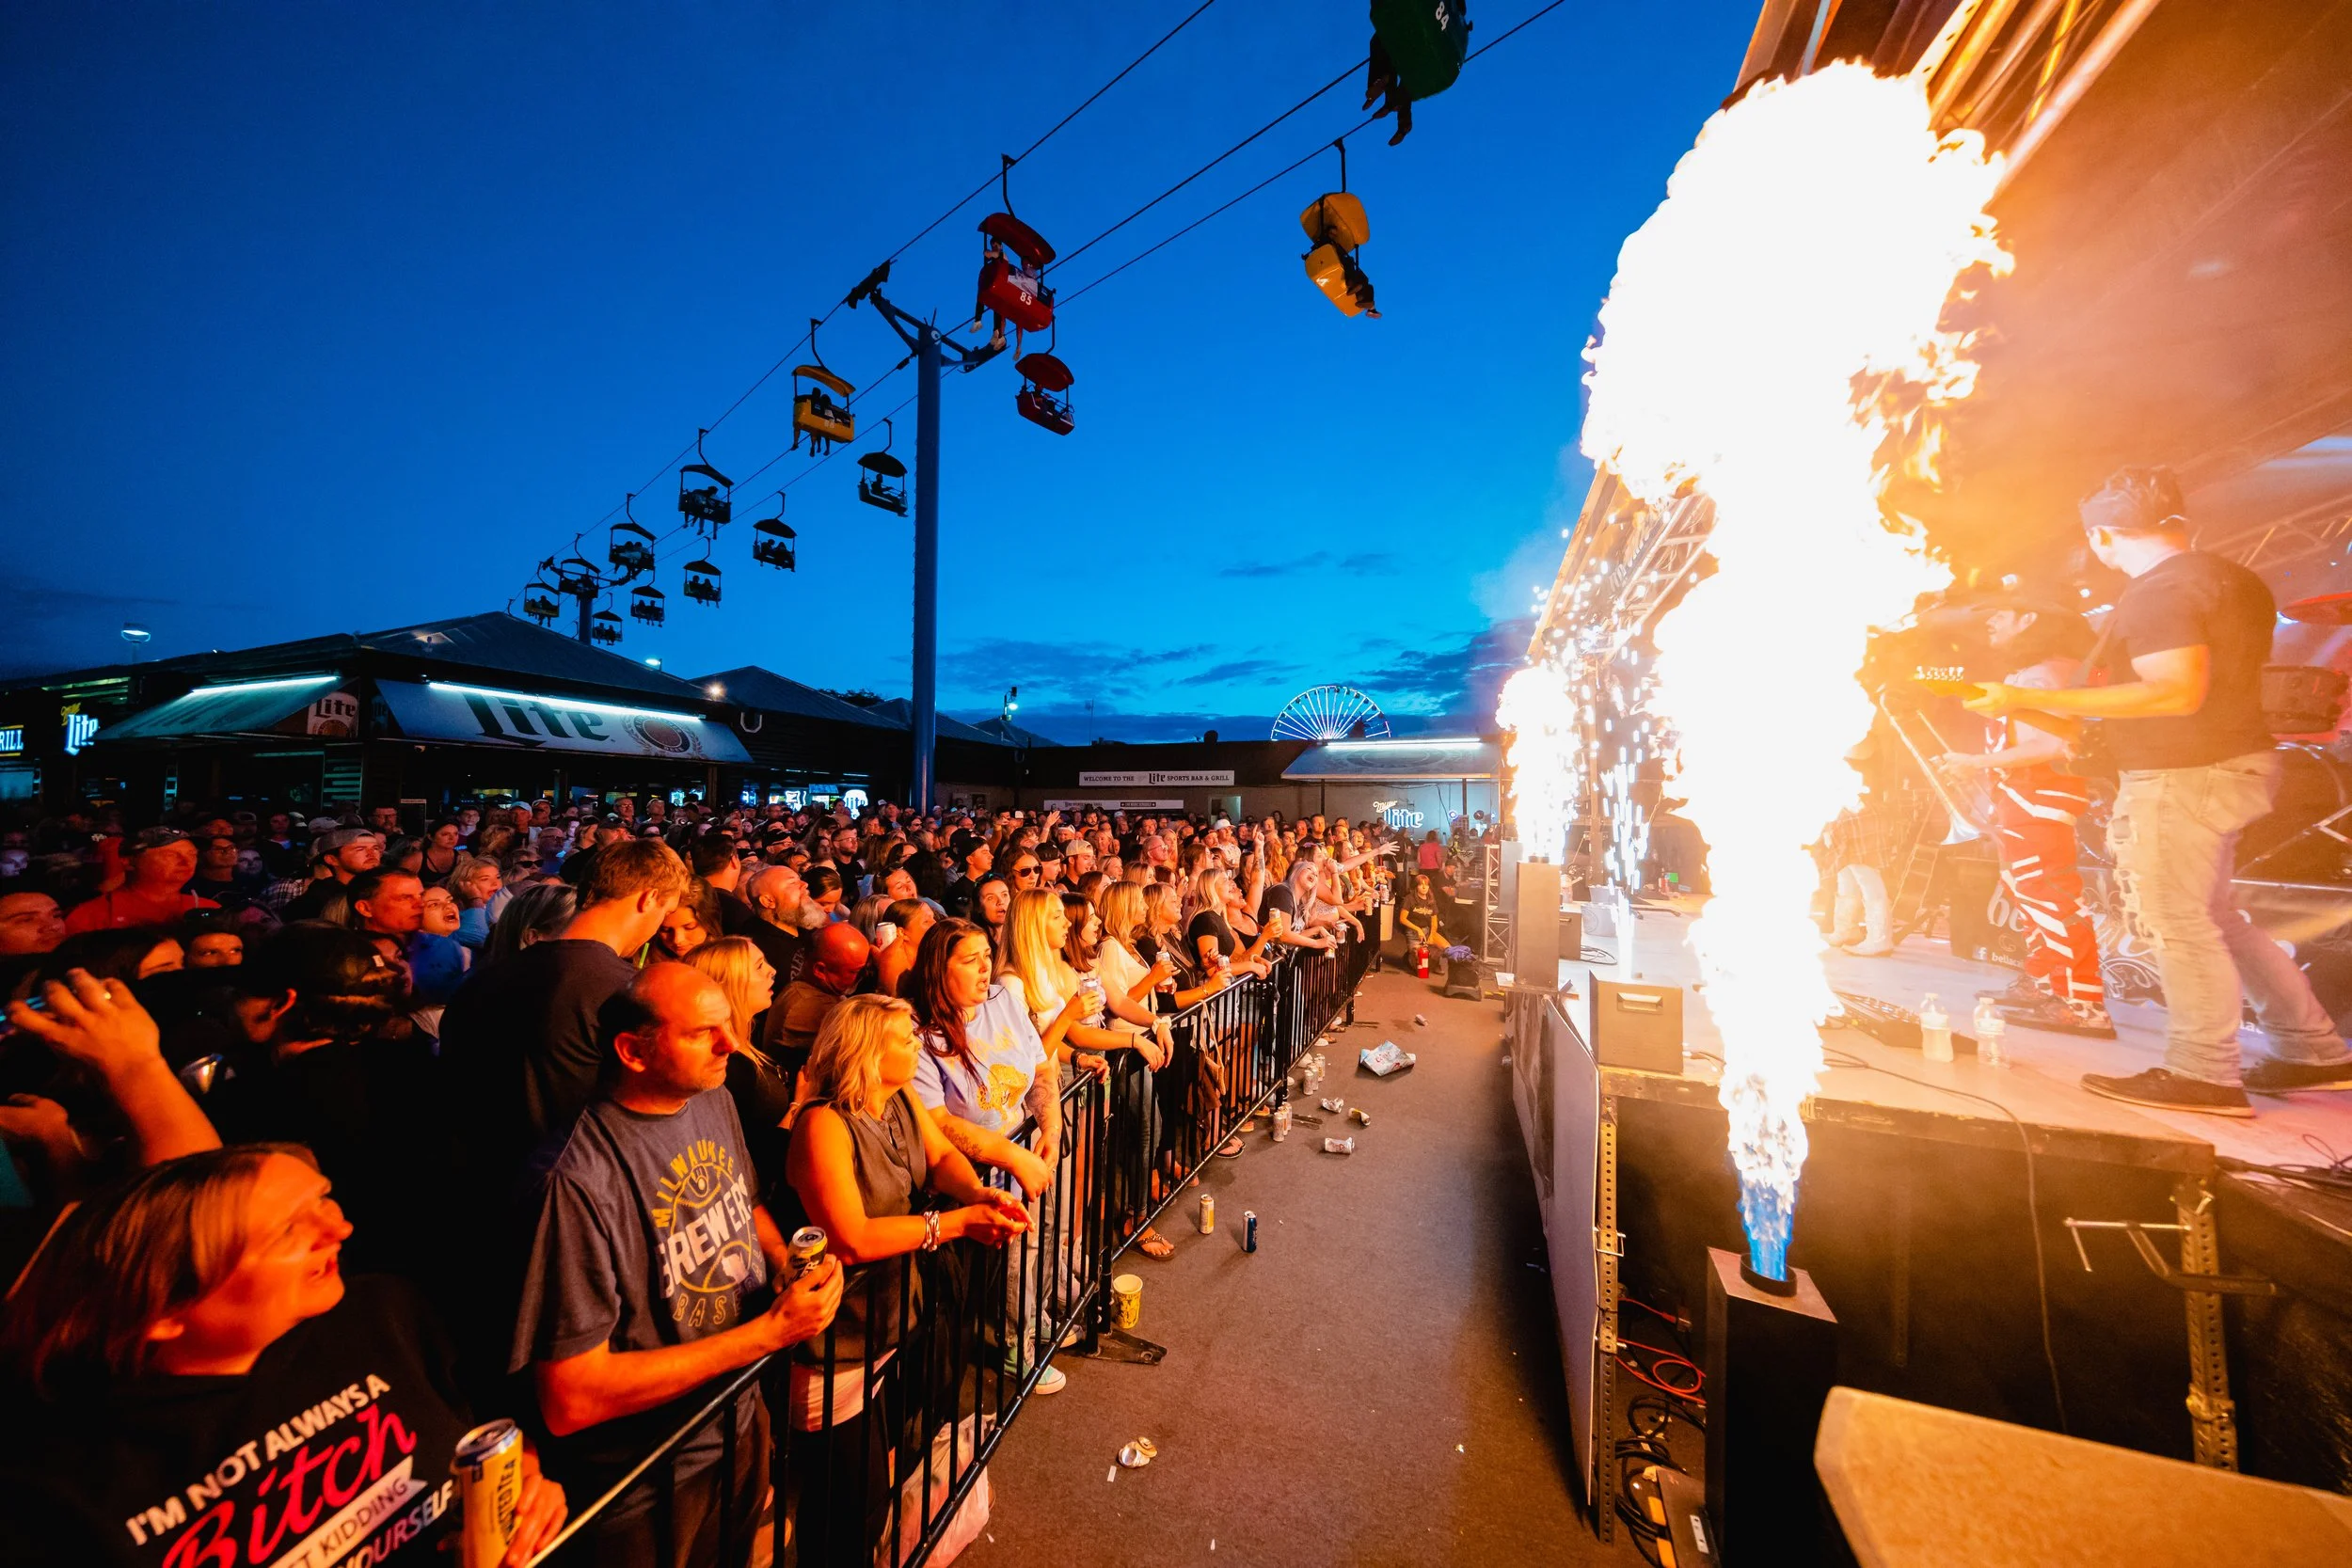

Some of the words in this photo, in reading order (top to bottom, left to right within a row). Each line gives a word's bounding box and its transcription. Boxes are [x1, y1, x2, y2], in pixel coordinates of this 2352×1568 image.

[1436, 1, 1449, 31] 84
[1020, 292, 1032, 306] 85
[315, 699, 356, 718] Lite
[463, 691, 610, 747] Lite
[1149, 773, 1166, 784] Lite
[651, 1139, 736, 1228] MILWAUKEE
[125, 1496, 187, 1546] I'M
[186, 1439, 262, 1512] NOT
[264, 1385, 370, 1462] ALWAYS
[363, 1374, 390, 1401] A
[161, 1402, 417, 1568] Bitch
[318, 1476, 408, 1558] KIDDING
